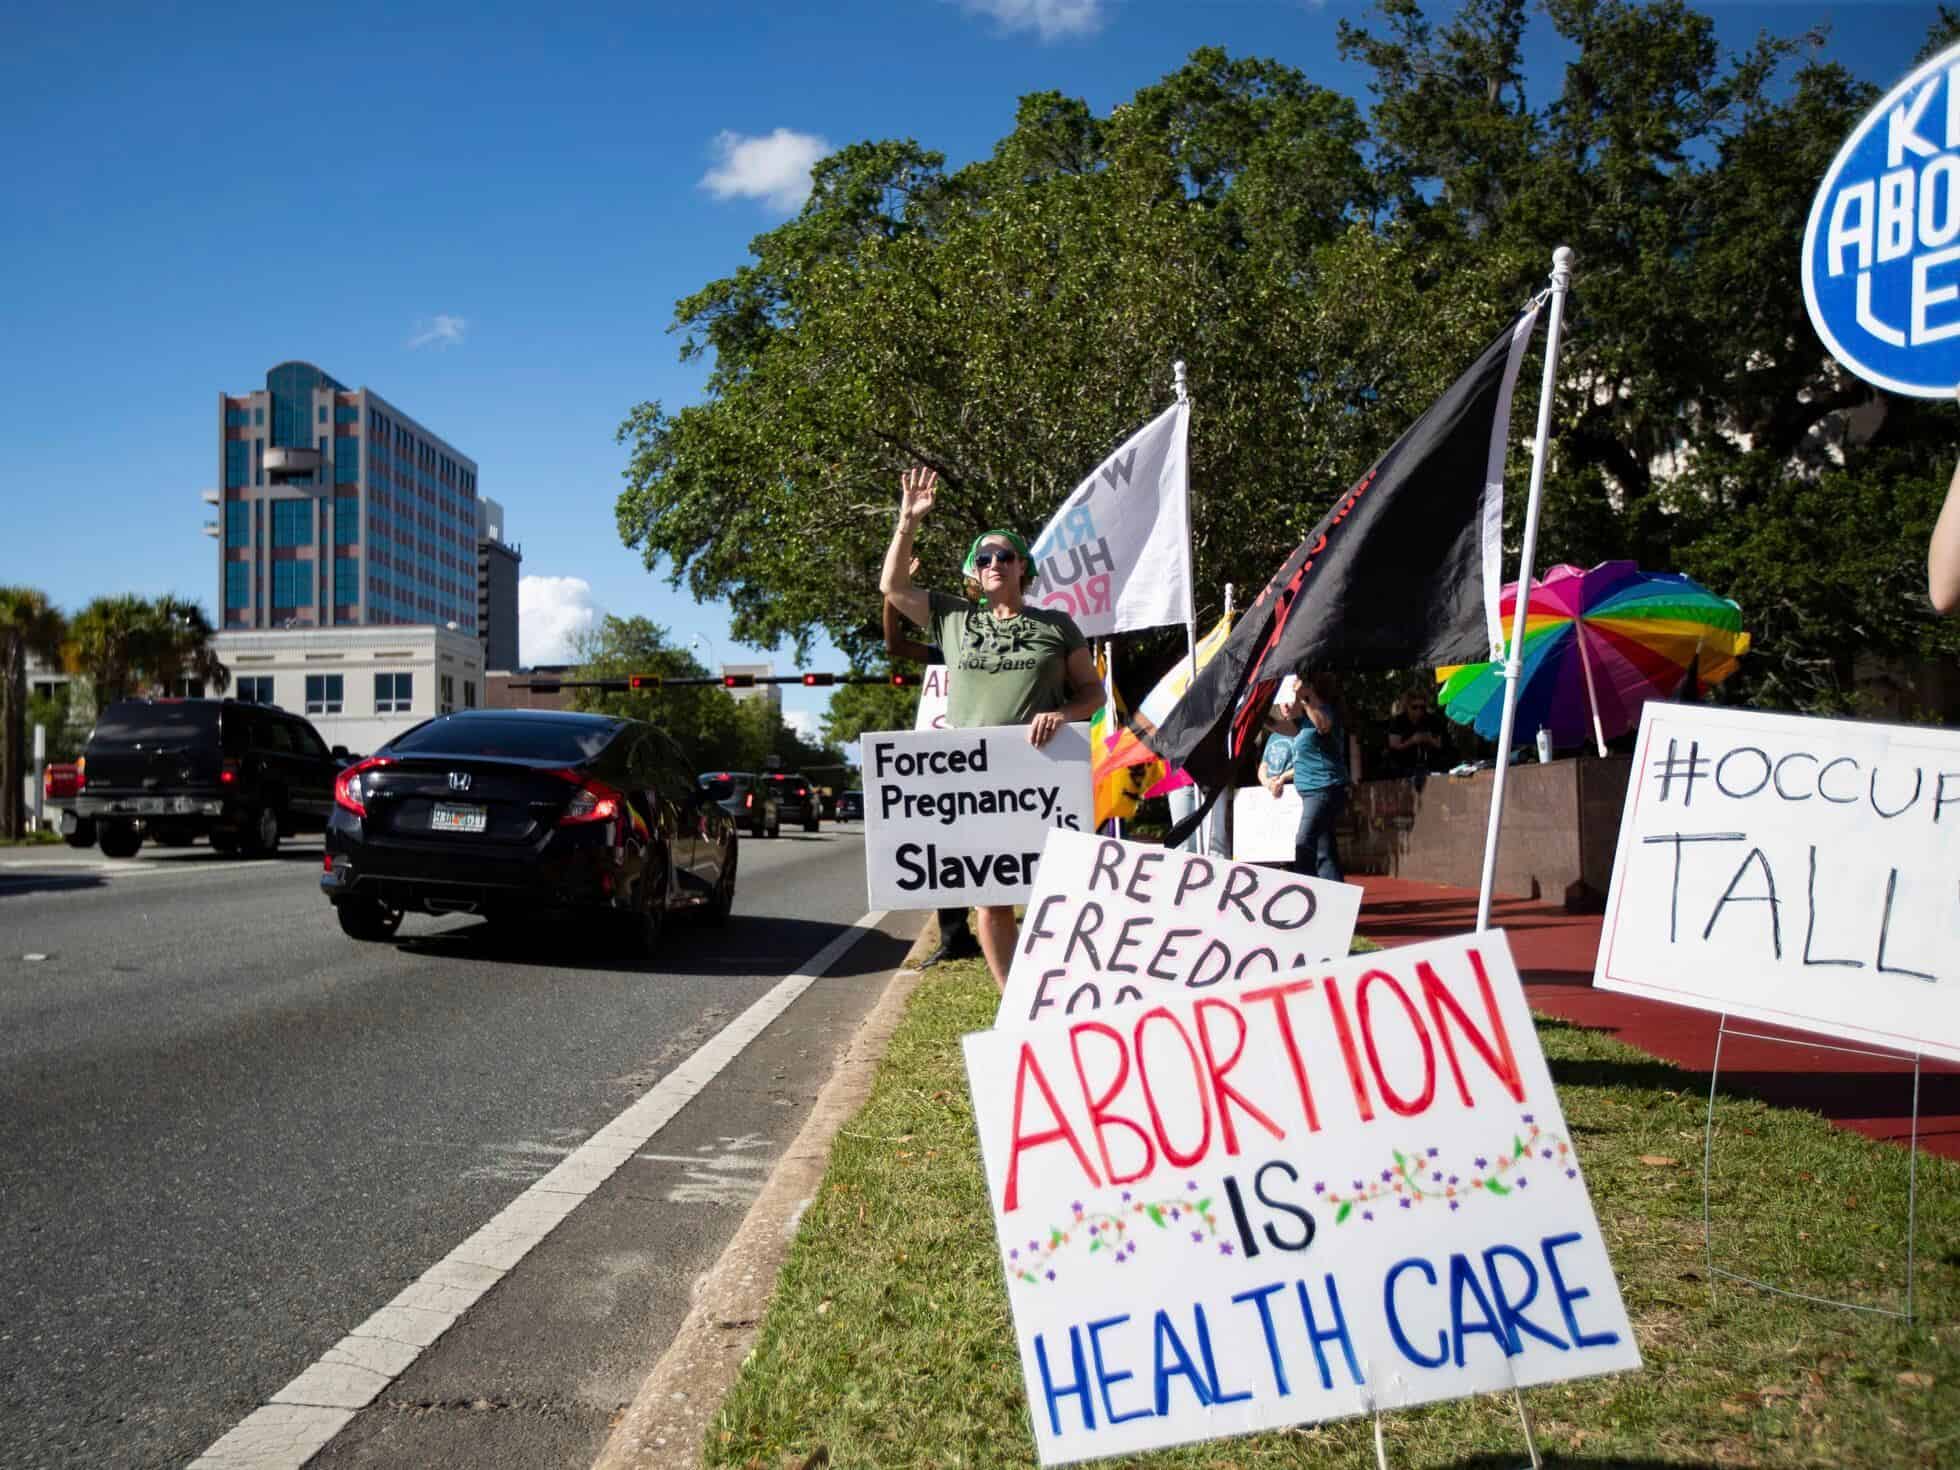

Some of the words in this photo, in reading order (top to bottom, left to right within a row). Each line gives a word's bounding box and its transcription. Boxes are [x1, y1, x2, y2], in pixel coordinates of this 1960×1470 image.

[875, 738, 988, 778] Forced
[881, 785, 1060, 825] Pregnancy
[1056, 806, 1080, 831] is
[895, 843, 1041, 891] Slaver
[1088, 839, 1317, 930] REPRO
[1643, 832, 1960, 983] TALL
[1024, 895, 1331, 988] FREEDO
[1003, 948, 1527, 1213] ABORTION
[1222, 1160, 1316, 1258] IS
[1034, 1273, 1366, 1436] HEALTH
[1384, 1231, 1619, 1369] CARE
